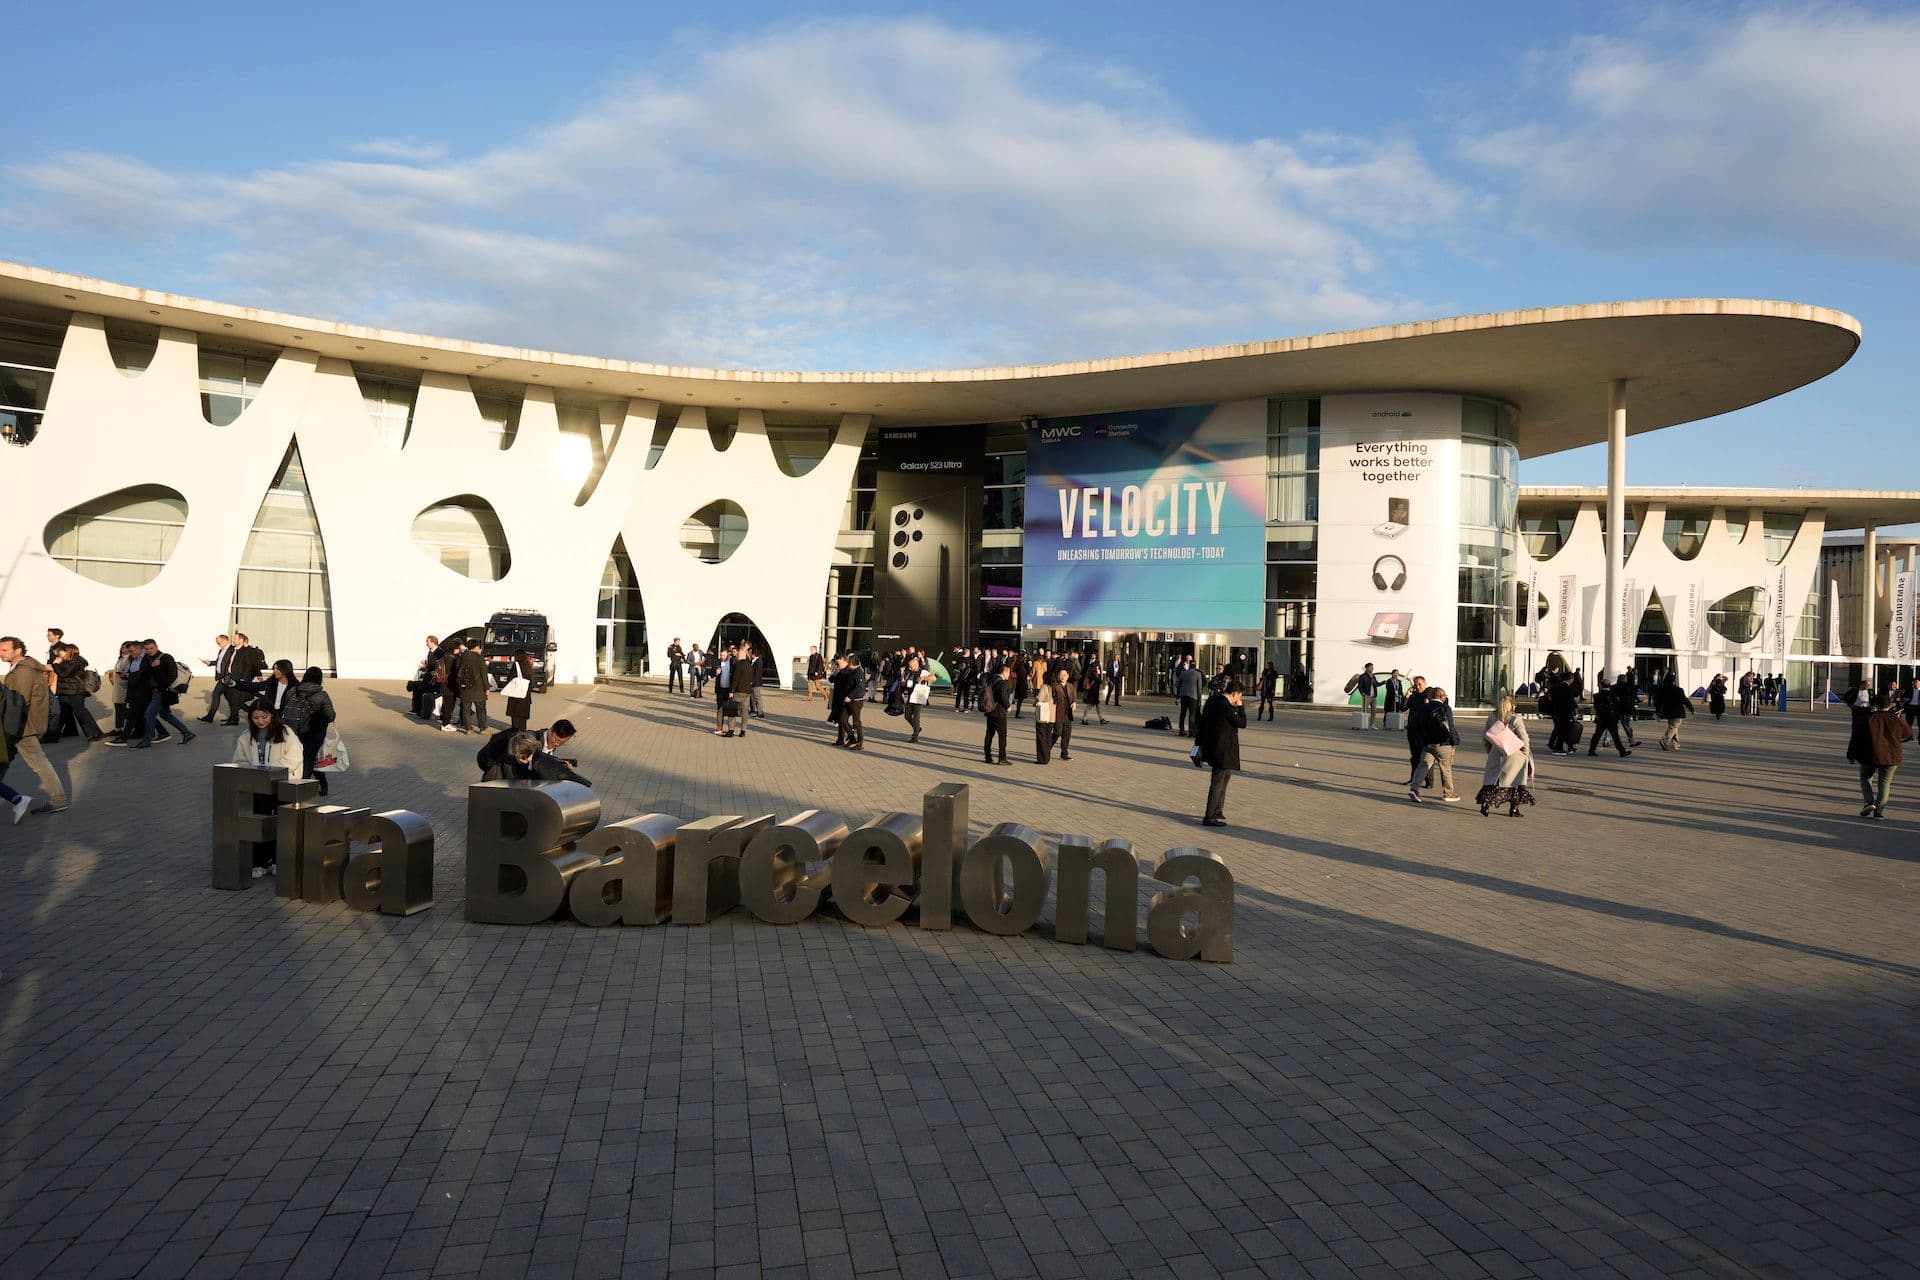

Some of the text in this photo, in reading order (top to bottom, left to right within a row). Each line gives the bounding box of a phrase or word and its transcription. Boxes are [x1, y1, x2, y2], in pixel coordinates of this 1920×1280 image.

[1041, 426, 1081, 438] MWC
[1356, 442, 1428, 455] Everything
[900, 461, 962, 471] Galaxy S23 Ultra
[1349, 457, 1432, 467] works better
[1362, 471, 1420, 484] together
[1058, 481, 1227, 539] VELOCITY
[1057, 549, 1100, 561] UNLEASHING
[1101, 548, 1148, 560] TOMORROW'S
[212, 763, 1235, 963] Fira Barcelona
